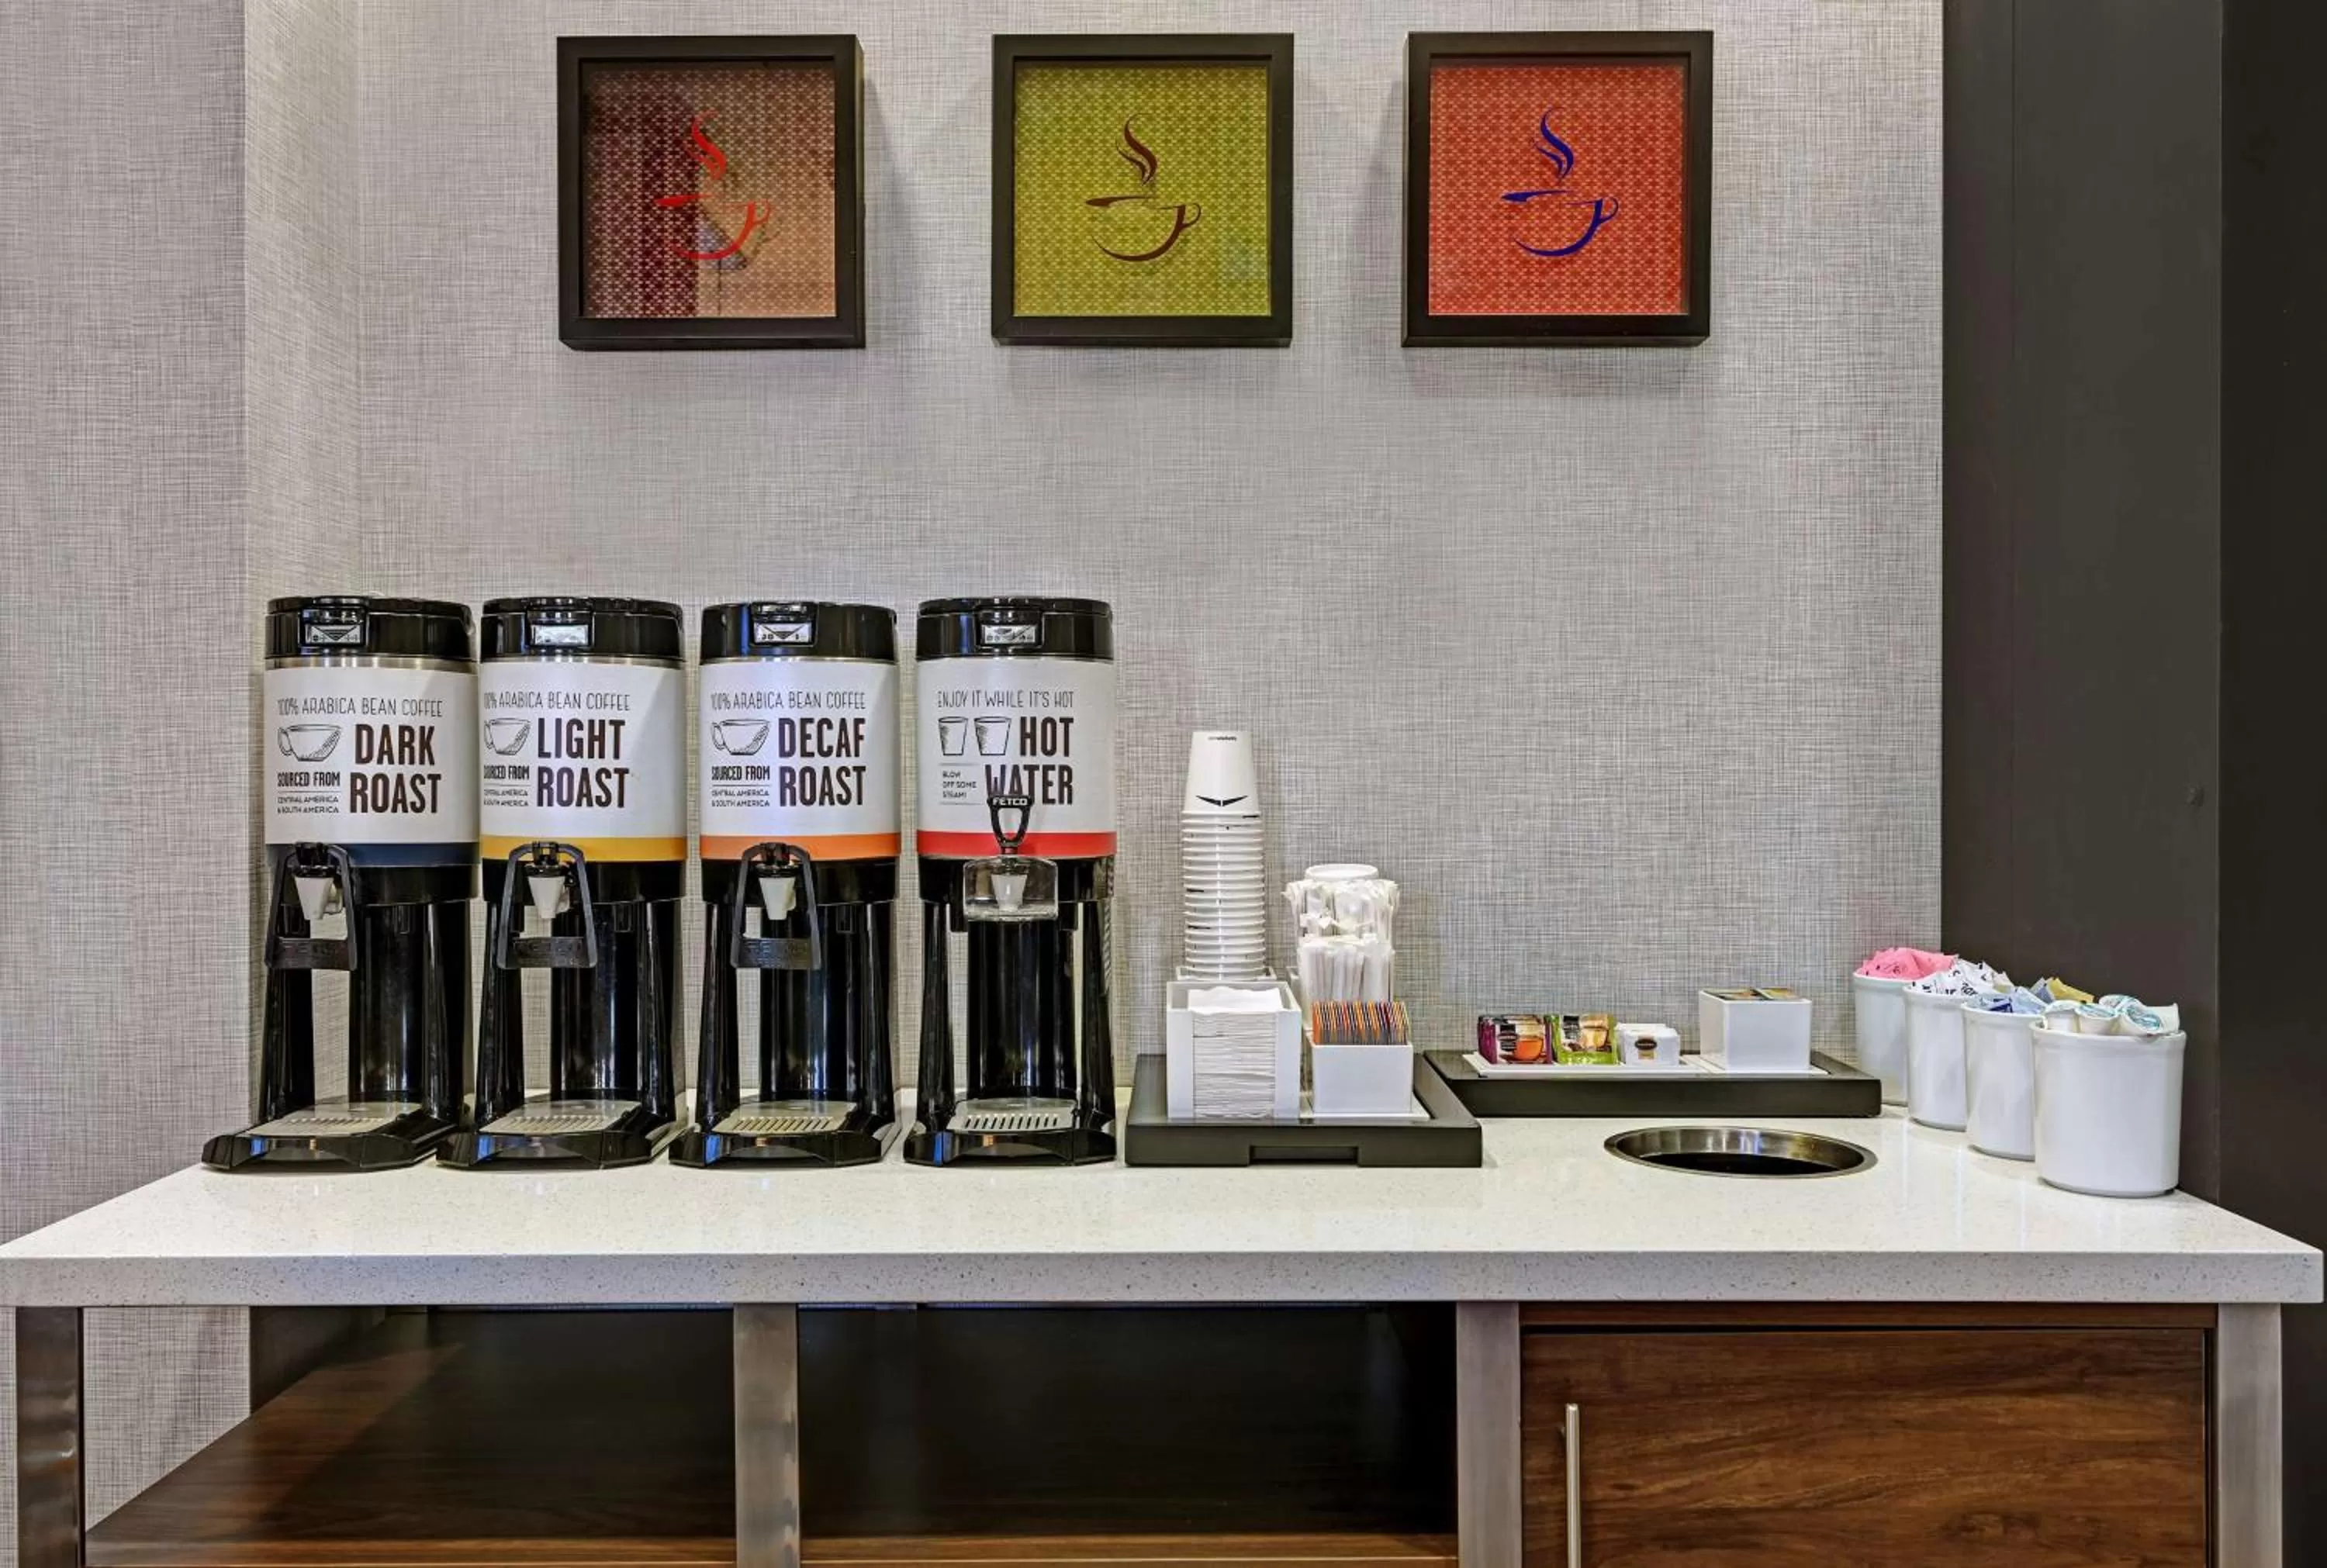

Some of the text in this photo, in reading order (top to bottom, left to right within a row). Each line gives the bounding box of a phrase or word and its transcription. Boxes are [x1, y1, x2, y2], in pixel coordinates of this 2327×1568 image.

[302, 697, 356, 714] ARABICA
[361, 698, 396, 715] BEAN
[402, 699, 443, 717] COFFEE
[499, 691, 544, 709] ARABICA
[548, 692, 581, 710] BEAN
[586, 692, 631, 711] COFFEE
[733, 692, 783, 710] ARABICA
[789, 691, 821, 709] BEAN
[825, 691, 866, 710] COFFEE
[937, 690, 1074, 708] ENJOY IT WHILE IT'S HOT
[355, 724, 435, 765] DARK
[538, 717, 625, 760] LIGHT
[778, 717, 866, 758] DECAF
[1020, 717, 1074, 757] HOT
[278, 772, 340, 786] SOURCED FROM
[509, 765, 530, 780] FROM
[711, 765, 770, 780] SOURCED FROM
[350, 772, 441, 813] ROAST
[537, 765, 629, 808] ROAST
[779, 765, 866, 806] ROAST
[985, 764, 1074, 805] WATER
[303, 795, 339, 803] AMERICA
[992, 796, 1028, 806] FETCO
